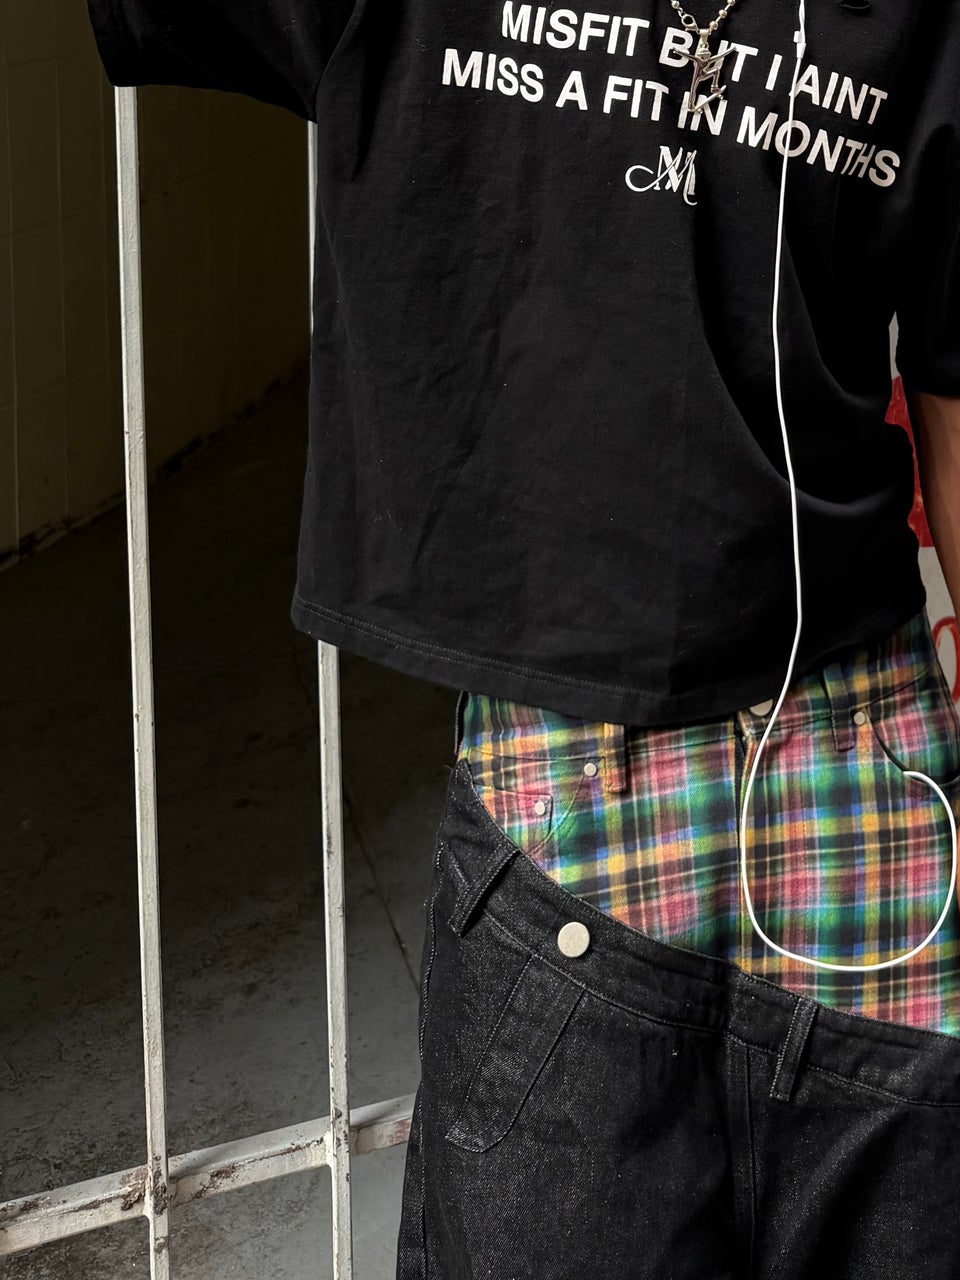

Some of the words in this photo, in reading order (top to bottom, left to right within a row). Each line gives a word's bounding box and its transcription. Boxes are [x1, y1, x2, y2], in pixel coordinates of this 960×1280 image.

[442, 48, 544, 103] MISS
[555, 70, 588, 110] A
[603, 75, 669, 122] FIT
[677, 91, 728, 136] IN
[736, 105, 900, 188] MONTHS
[501, 0, 650, 57] MISFIT
[765, 53, 783, 91] I
[788, 63, 889, 125] AINT
